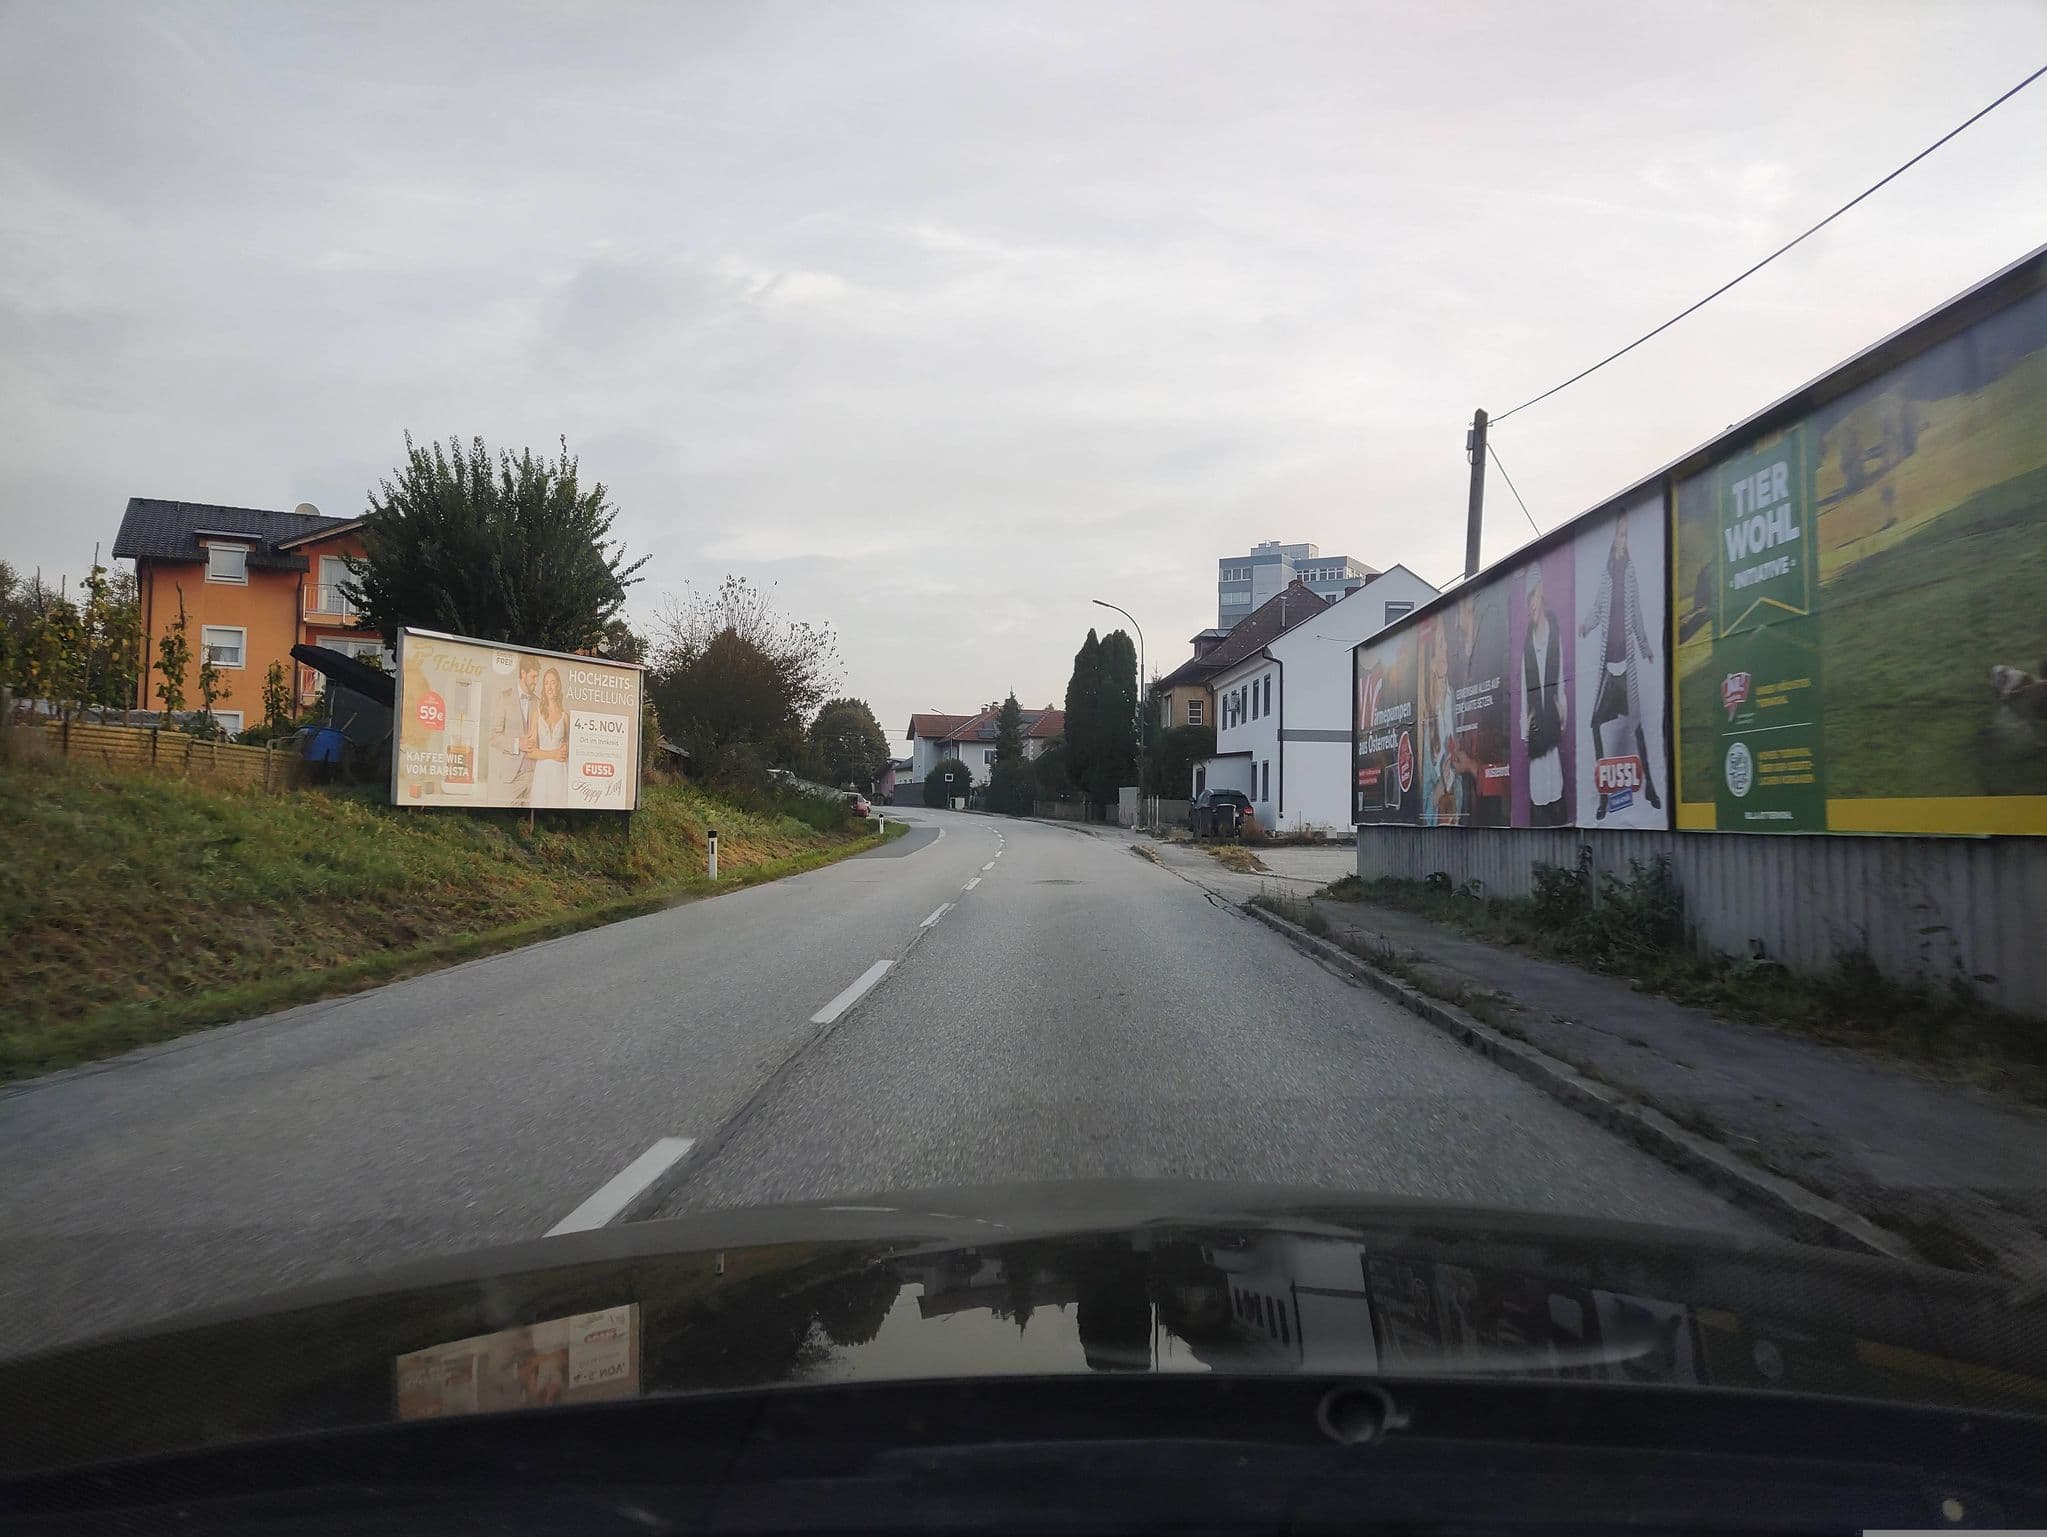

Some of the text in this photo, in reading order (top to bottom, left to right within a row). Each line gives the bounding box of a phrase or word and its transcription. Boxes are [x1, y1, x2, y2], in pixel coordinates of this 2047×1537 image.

[1732, 461, 1789, 518] TIER
[1725, 502, 1801, 562] WOHL
[569, 669, 633, 690] HOCHZEITS-
[420, 706, 443, 721] 59€
[599, 720, 624, 734] NOV.
[406, 751, 464, 764] KAFFEE WIE
[406, 764, 469, 777] VOM BARISTA
[585, 764, 613, 776] FUSSL
[1599, 762, 1640, 788] FUSSL
